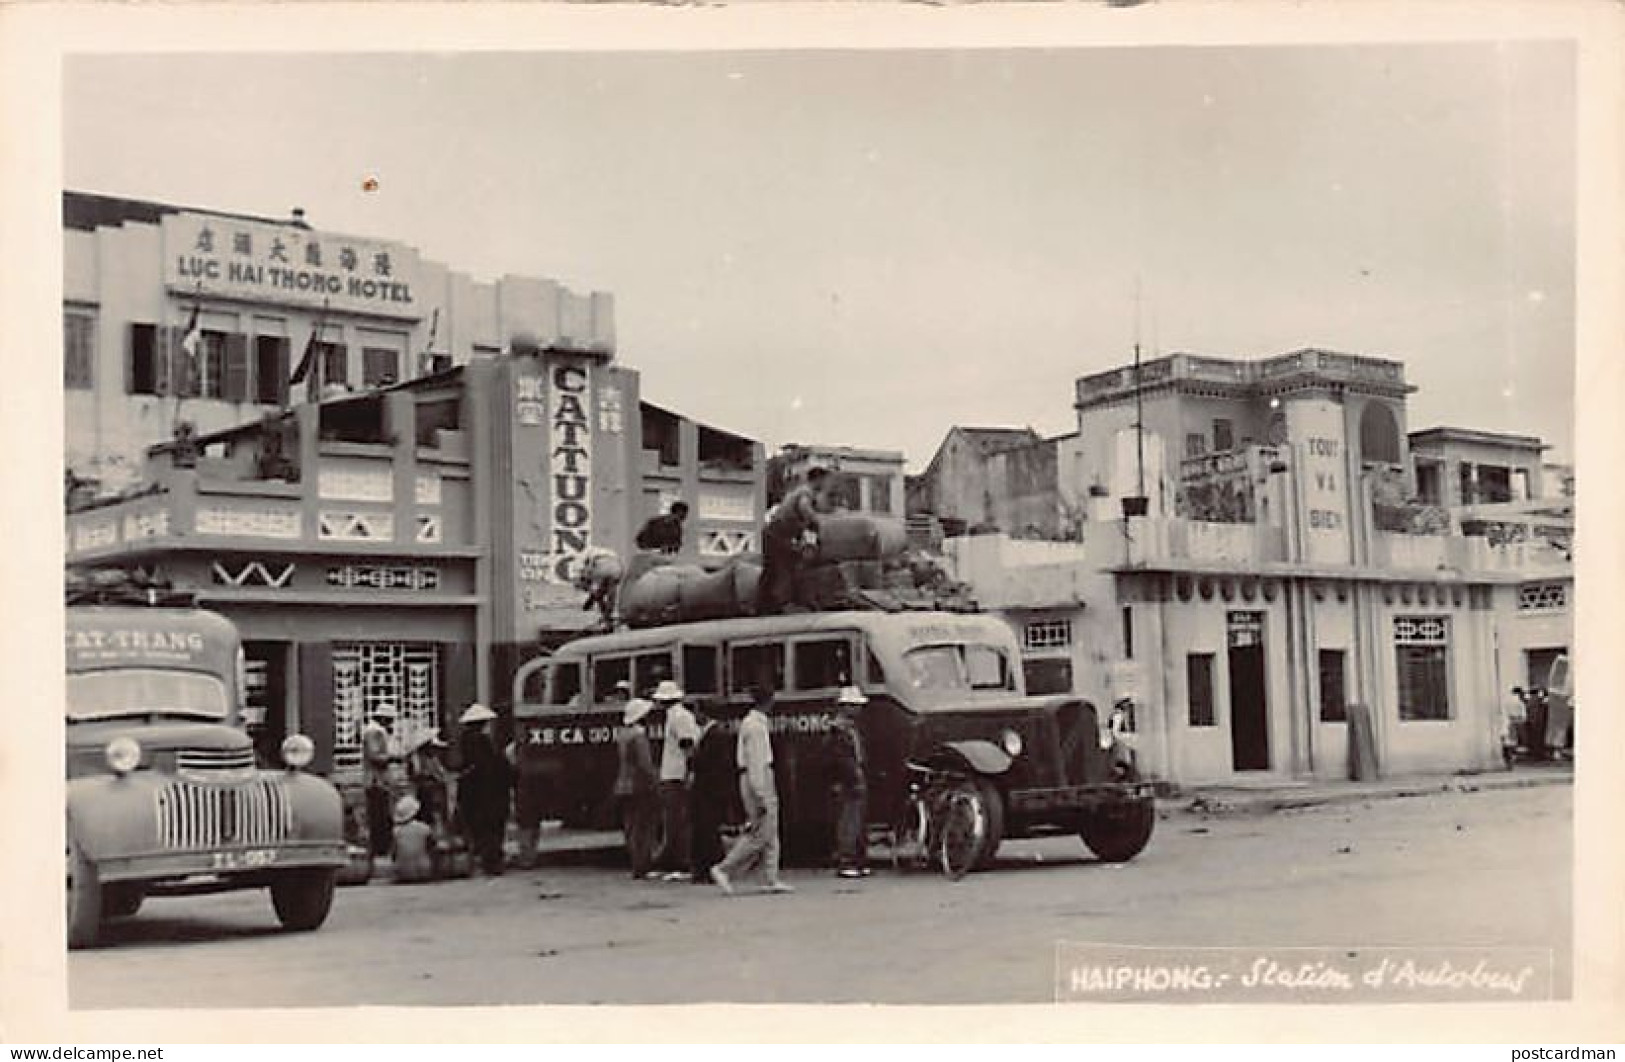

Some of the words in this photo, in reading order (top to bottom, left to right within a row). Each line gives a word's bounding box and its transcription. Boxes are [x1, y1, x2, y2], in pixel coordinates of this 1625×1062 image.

[178, 256, 220, 278] LUC
[228, 262, 264, 284] HAI
[268, 268, 342, 294] THONG
[348, 278, 413, 302] HOTEL
[1316, 473, 1336, 492] VA
[529, 728, 555, 744] XE
[560, 727, 584, 744] CA
